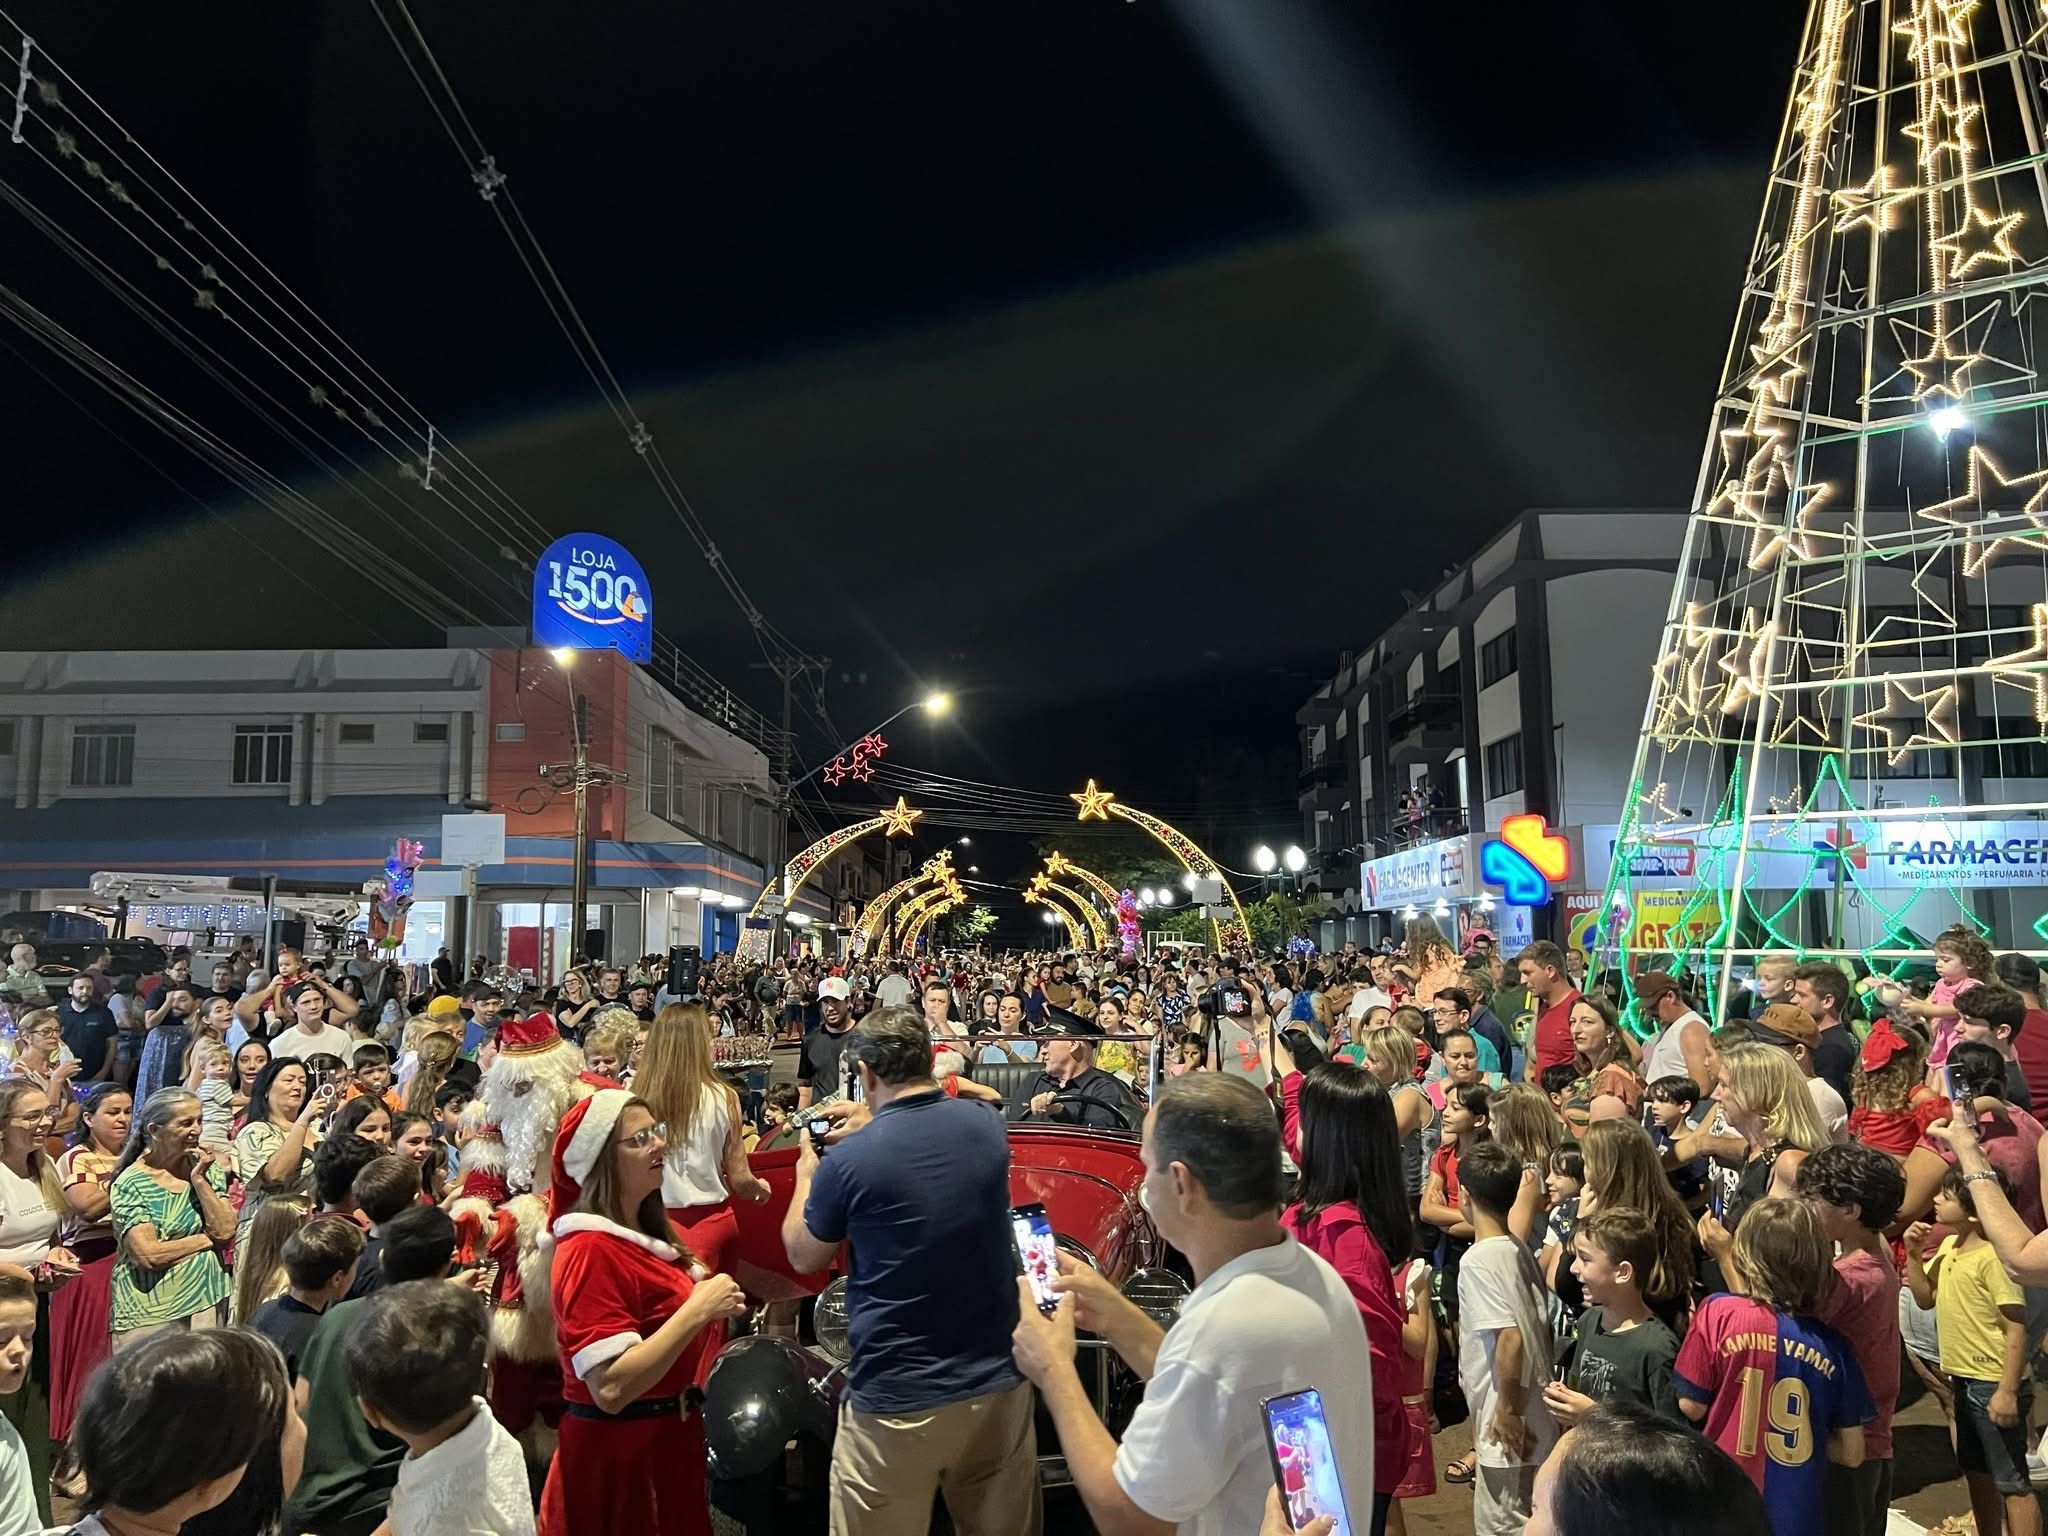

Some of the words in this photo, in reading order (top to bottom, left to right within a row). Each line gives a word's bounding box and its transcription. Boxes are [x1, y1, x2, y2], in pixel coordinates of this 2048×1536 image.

[572, 547, 616, 571] LOJA
[549, 561, 637, 611] 1500
[1979, 869, 2034, 878] PERFUMARIA
[1567, 895, 1599, 909] AQUI
[1718, 1332, 1776, 1358] LAMINE
[1783, 1338, 1836, 1381] YAMAL
[1735, 1367, 1814, 1466] 19
